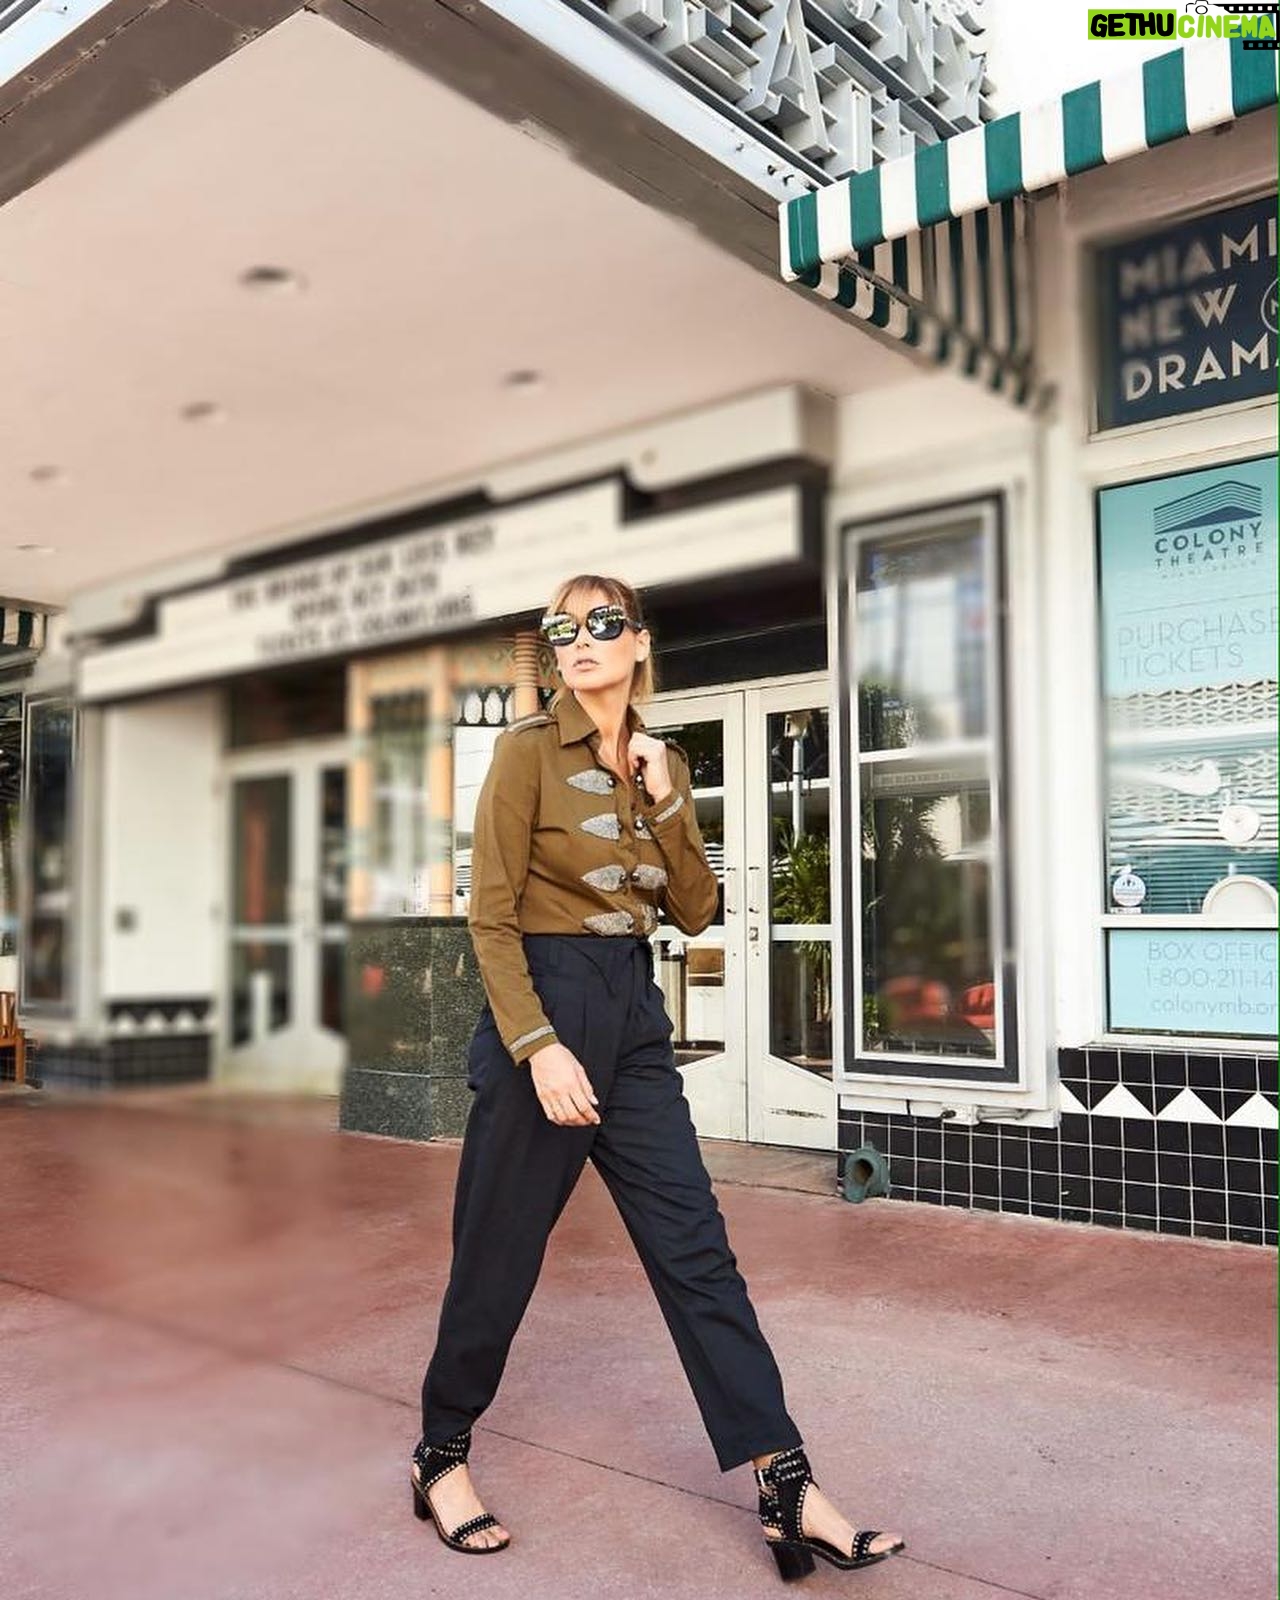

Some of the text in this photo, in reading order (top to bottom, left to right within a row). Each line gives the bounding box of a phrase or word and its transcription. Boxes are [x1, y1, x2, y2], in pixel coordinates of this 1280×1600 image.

[1120, 217, 1277, 298] MIAMI
[1120, 284, 1237, 347] NEW
[1122, 333, 1278, 401] DRAM
[1155, 522, 1262, 553] COLONY
[1155, 542, 1263, 568] THEATRE
[1120, 642, 1244, 678] TICKETS
[1149, 941, 1195, 961] BOX
